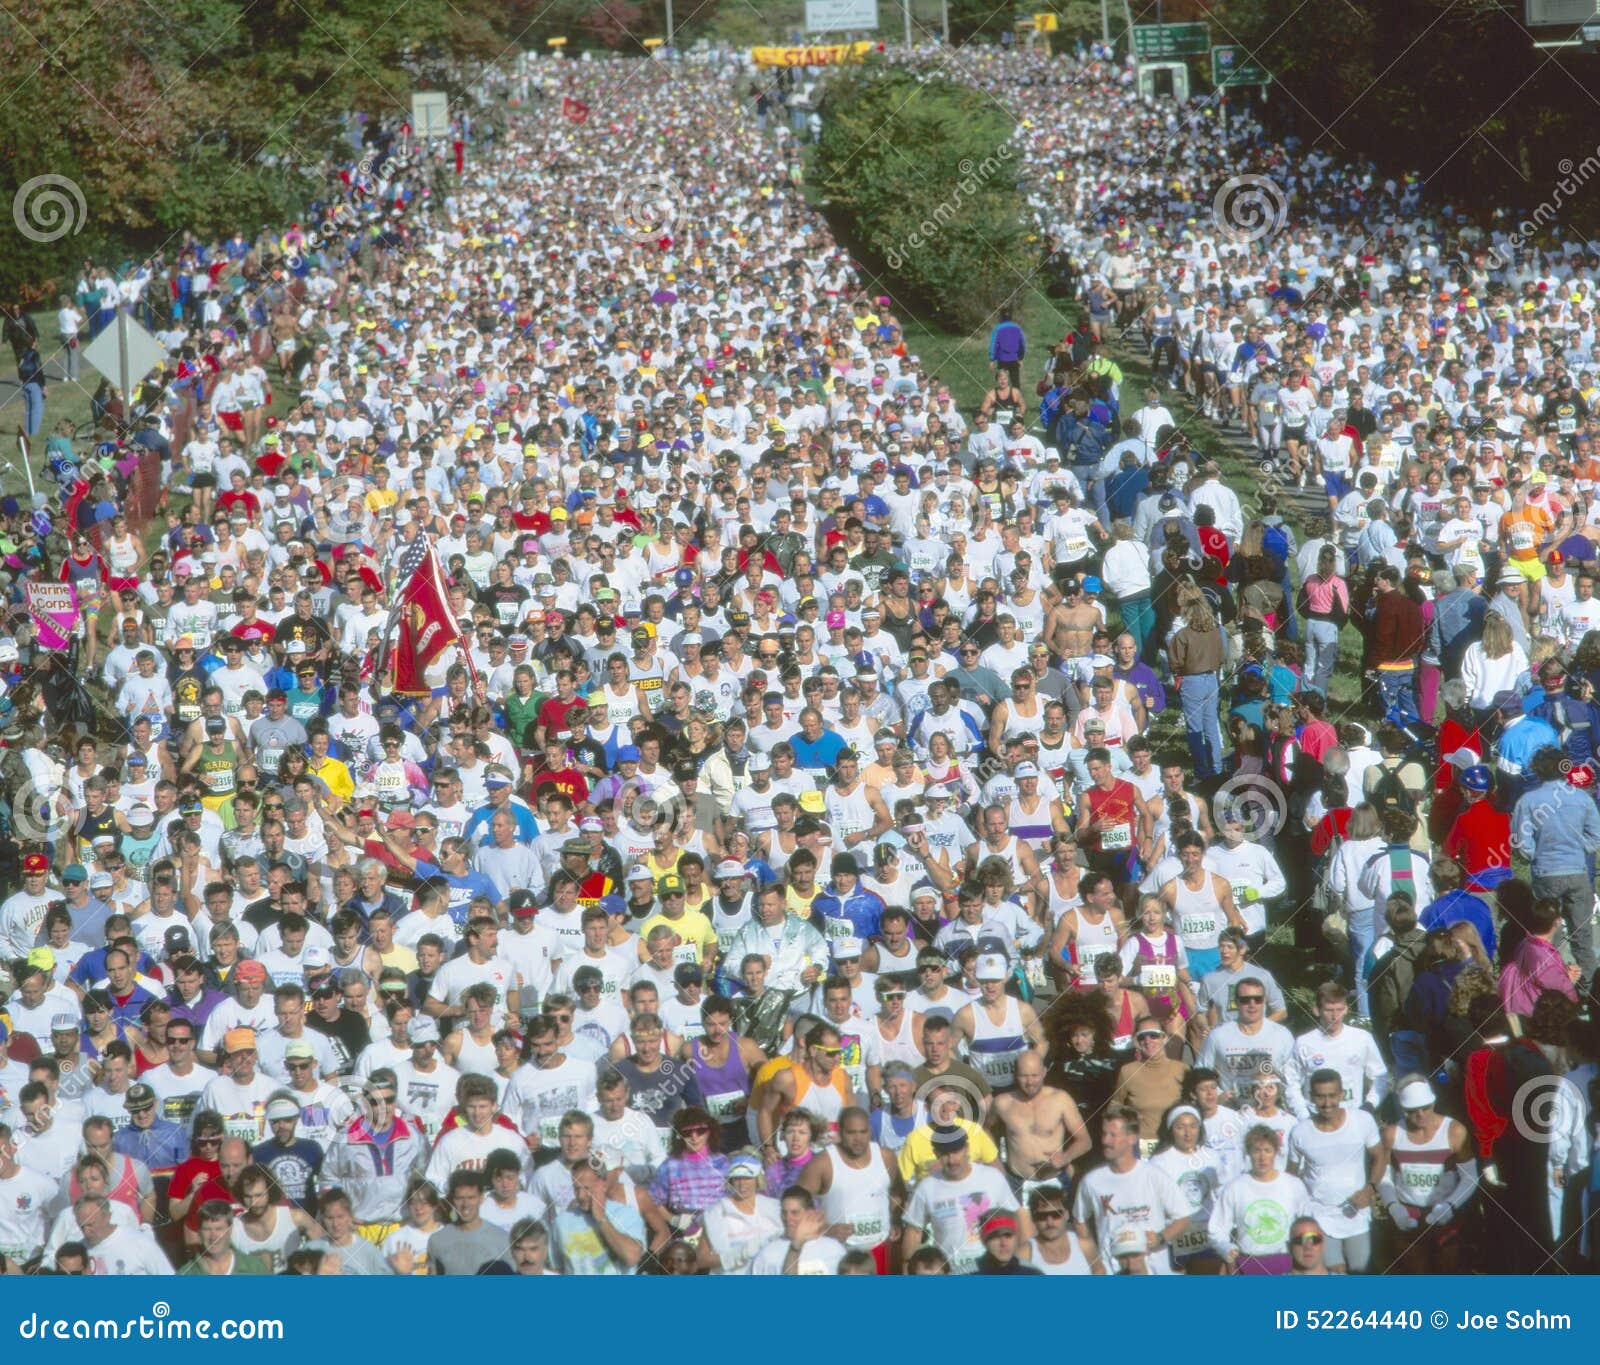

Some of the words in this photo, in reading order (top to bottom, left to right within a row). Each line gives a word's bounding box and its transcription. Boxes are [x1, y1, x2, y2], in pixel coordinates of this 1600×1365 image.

[784, 50, 838, 66] START
[30, 583, 69, 594] Marine
[36, 598, 72, 611] Corps
[1183, 920, 1215, 933] A12348
[1405, 1173, 1440, 1187] A3609
